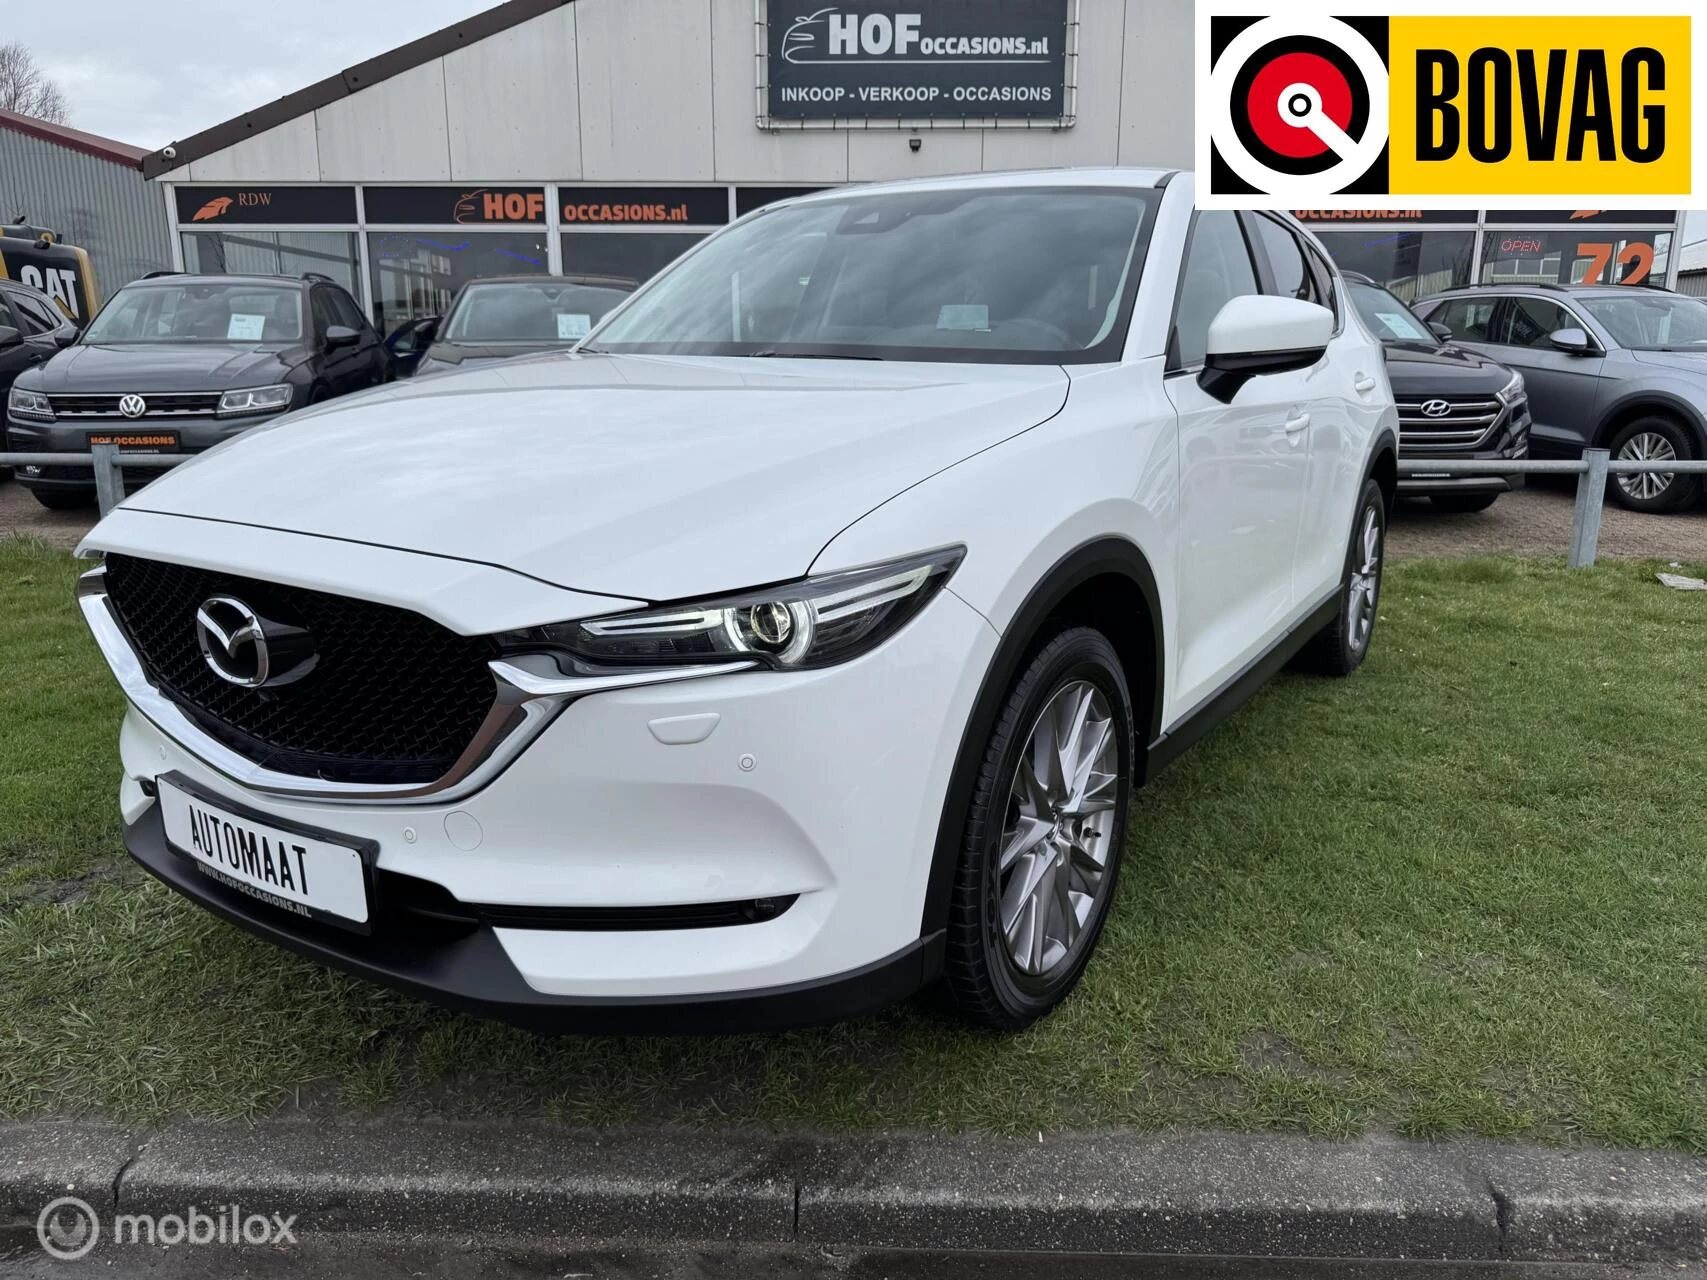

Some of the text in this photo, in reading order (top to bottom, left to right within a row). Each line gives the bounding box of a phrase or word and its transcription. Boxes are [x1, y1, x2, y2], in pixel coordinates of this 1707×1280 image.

[828, 13, 1049, 55] HOF OCCASIONS.nl
[781, 86, 845, 102] INKOOP
[858, 86, 940, 102] VERKOOP
[953, 86, 1052, 102] OCCASIONS
[238, 192, 272, 206] RDW
[483, 193, 689, 221] HOF OCCASIONS.nl
[1501, 240, 1542, 252] OPEN
[1576, 242, 1655, 286] 72
[20, 265, 80, 319] CAT
[113, 436, 176, 445] OCCASIONS
[189, 804, 308, 895] AUTOMAAT
[196, 860, 312, 918] WWW.HOFOCCASIONS.NL
